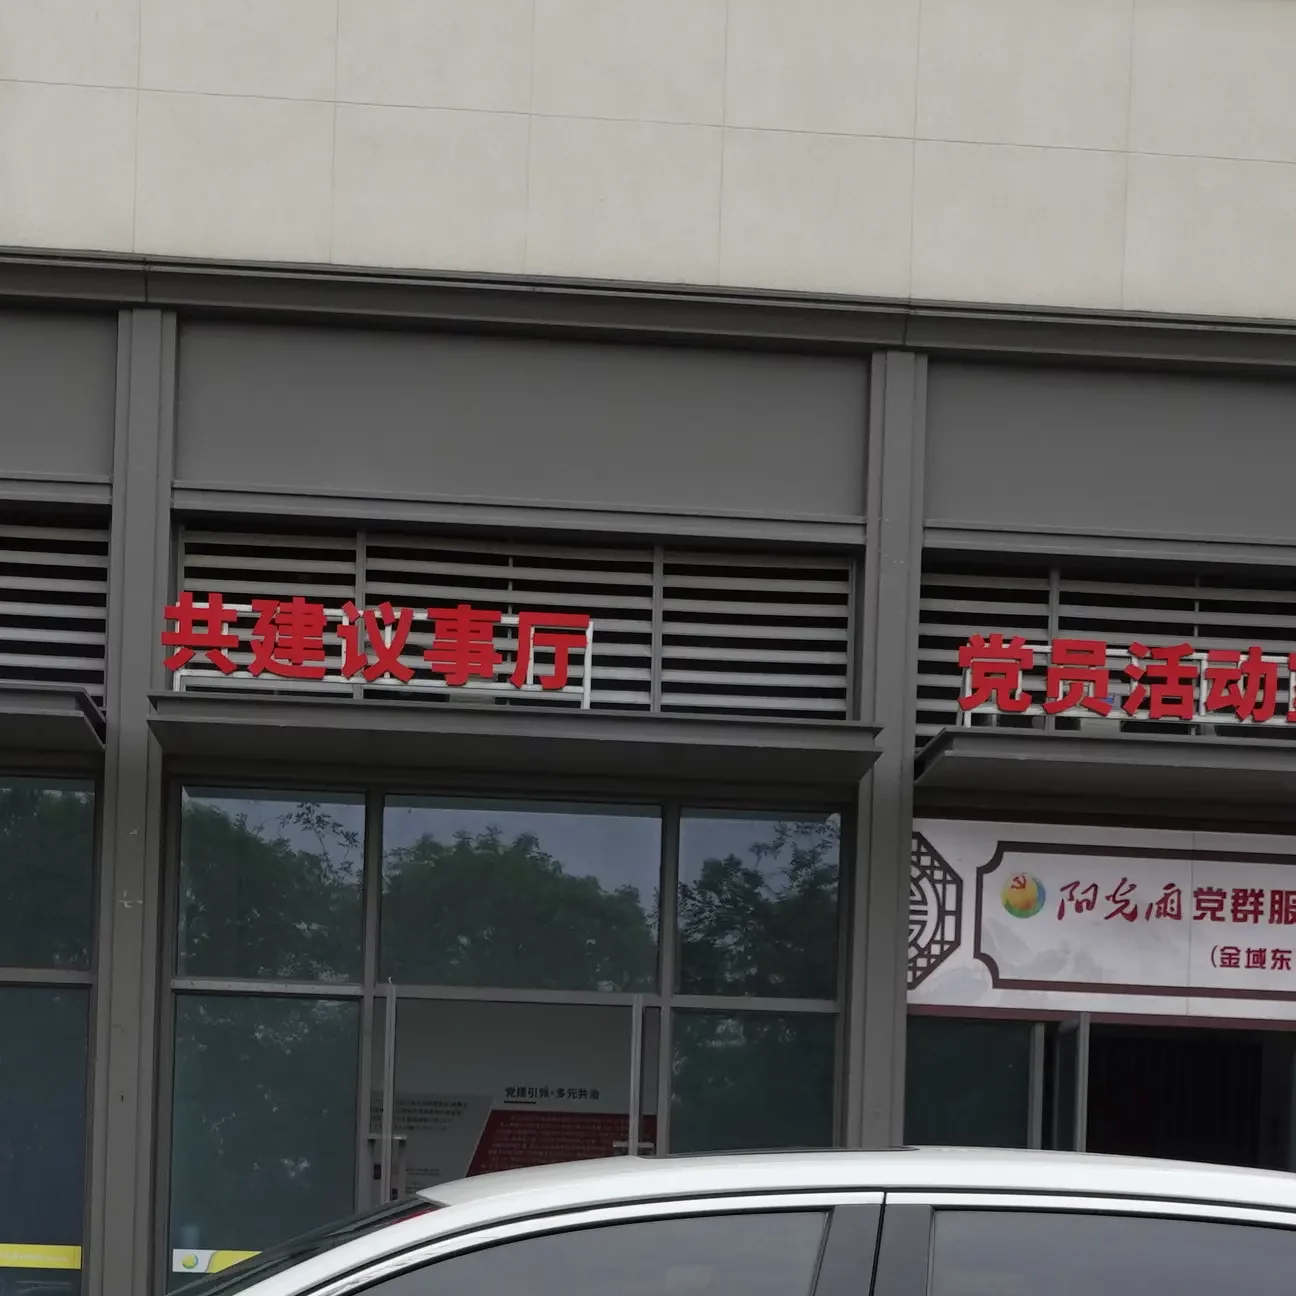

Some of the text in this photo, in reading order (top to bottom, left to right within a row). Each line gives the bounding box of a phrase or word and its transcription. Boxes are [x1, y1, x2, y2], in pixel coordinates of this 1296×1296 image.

[161, 592, 590, 690] 共建议事厅
